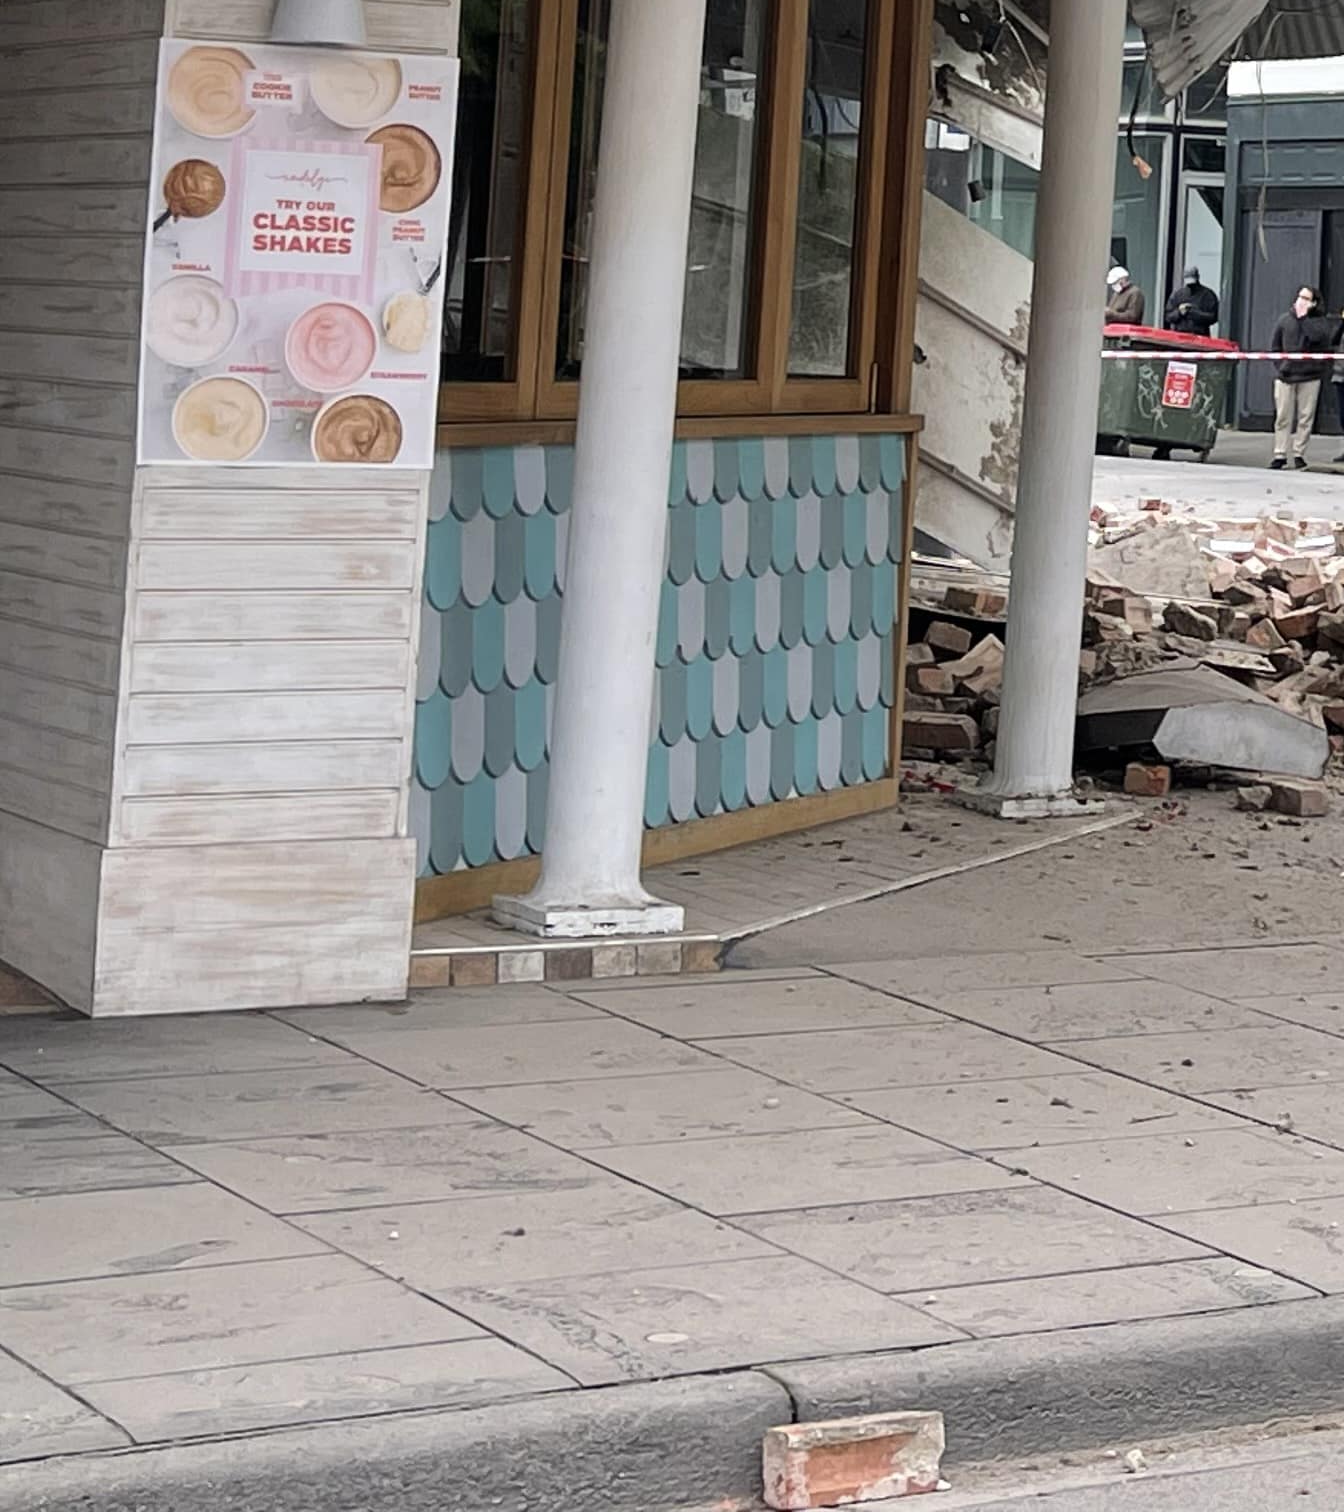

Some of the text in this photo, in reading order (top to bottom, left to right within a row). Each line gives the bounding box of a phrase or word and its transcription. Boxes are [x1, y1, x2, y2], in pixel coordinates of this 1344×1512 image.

[276, 199, 336, 212] TRY OUR
[253, 212, 355, 233] CLASSIC
[253, 234, 352, 255] SHAKES
